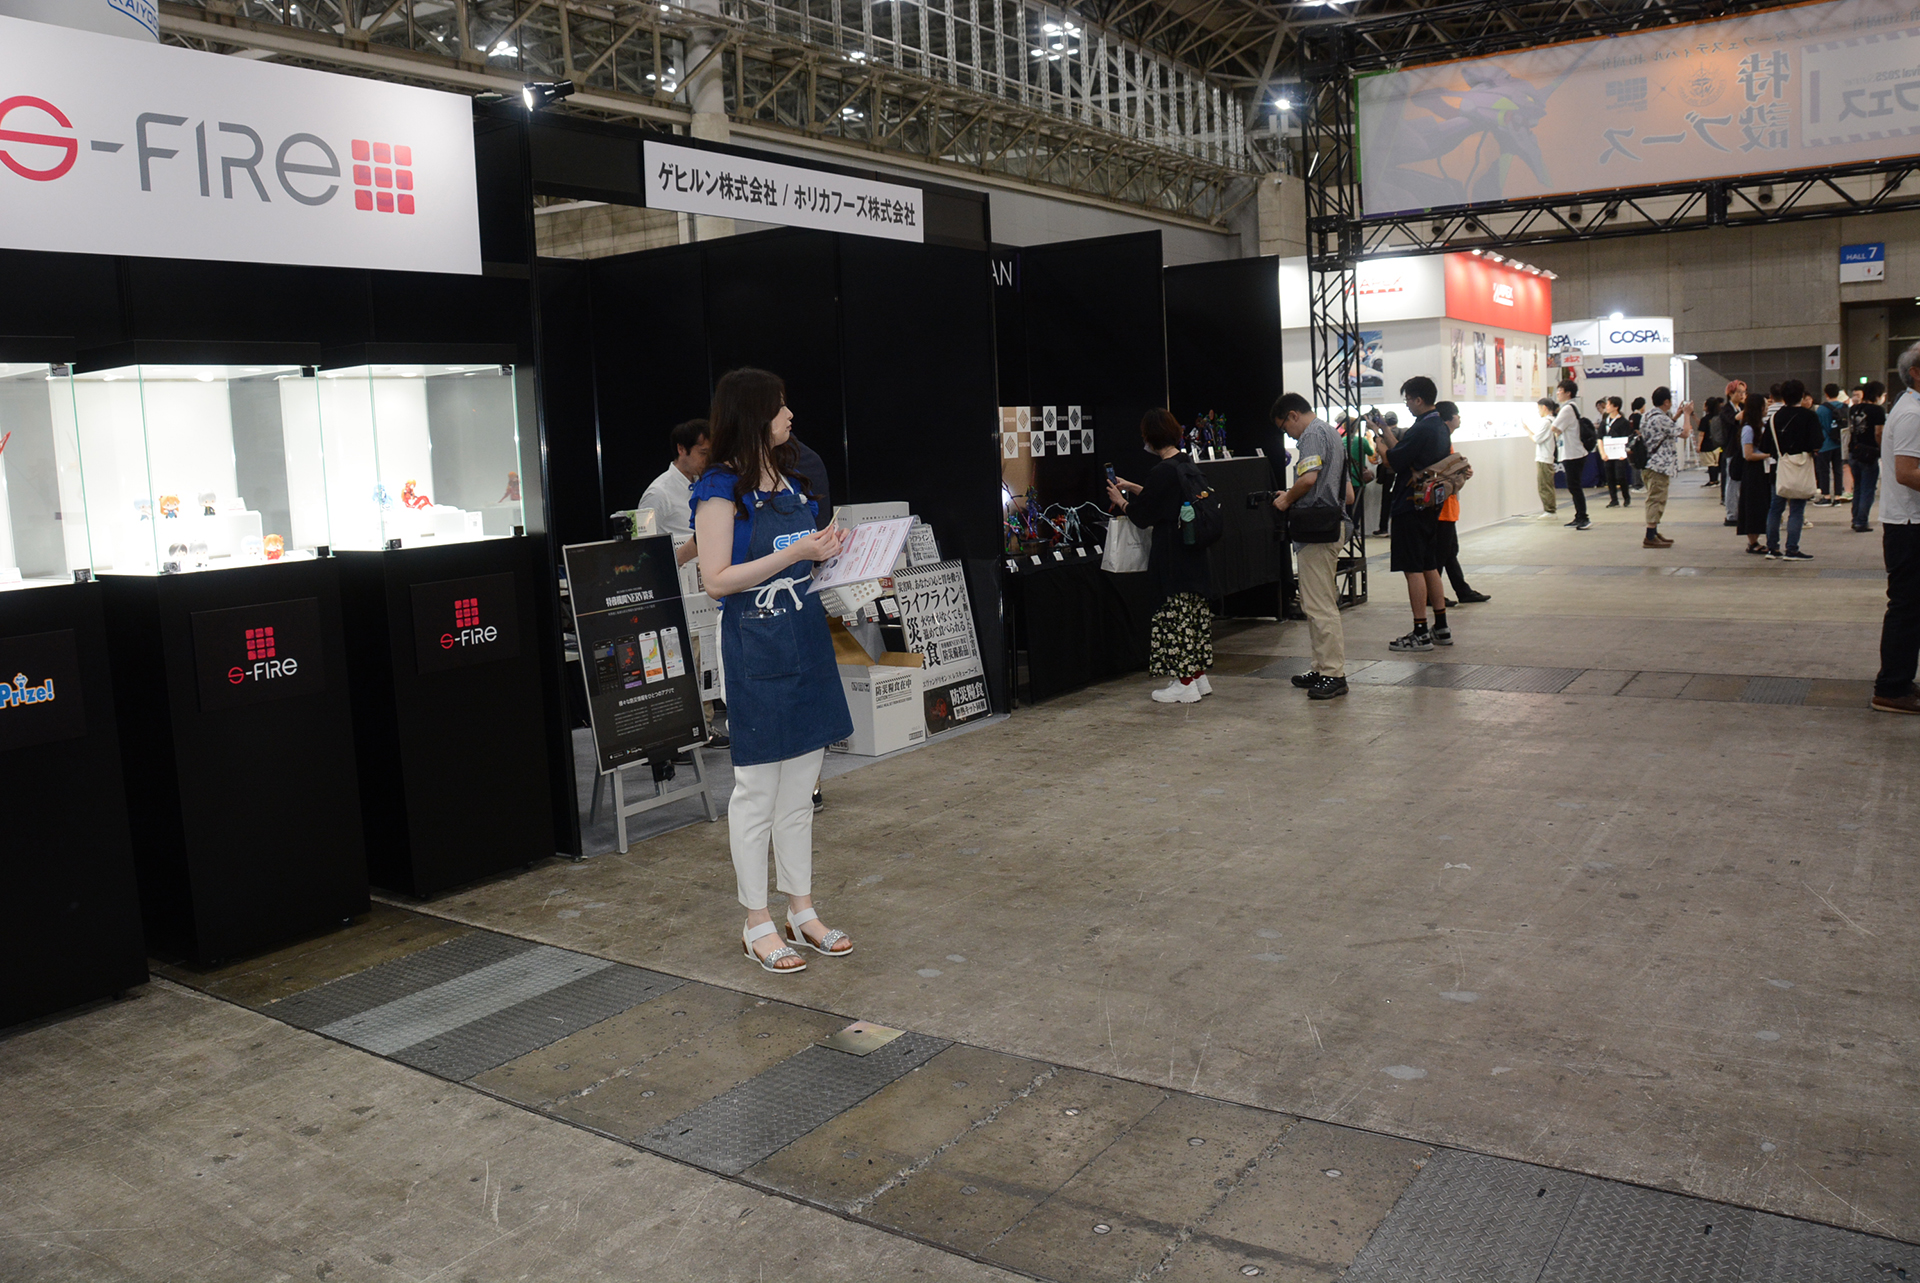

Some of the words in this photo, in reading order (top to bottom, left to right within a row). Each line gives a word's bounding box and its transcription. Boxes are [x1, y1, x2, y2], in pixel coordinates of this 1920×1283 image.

[658, 161, 777, 207] ゲヒルン株式会社
[794, 184, 917, 227] ホリカフーズ株式会社
[1845, 253, 1867, 261] HALL
[1868, 246, 1878, 259] 7
[1609, 329, 1662, 344] COSPA
[900, 586, 960, 616] ライフライン
